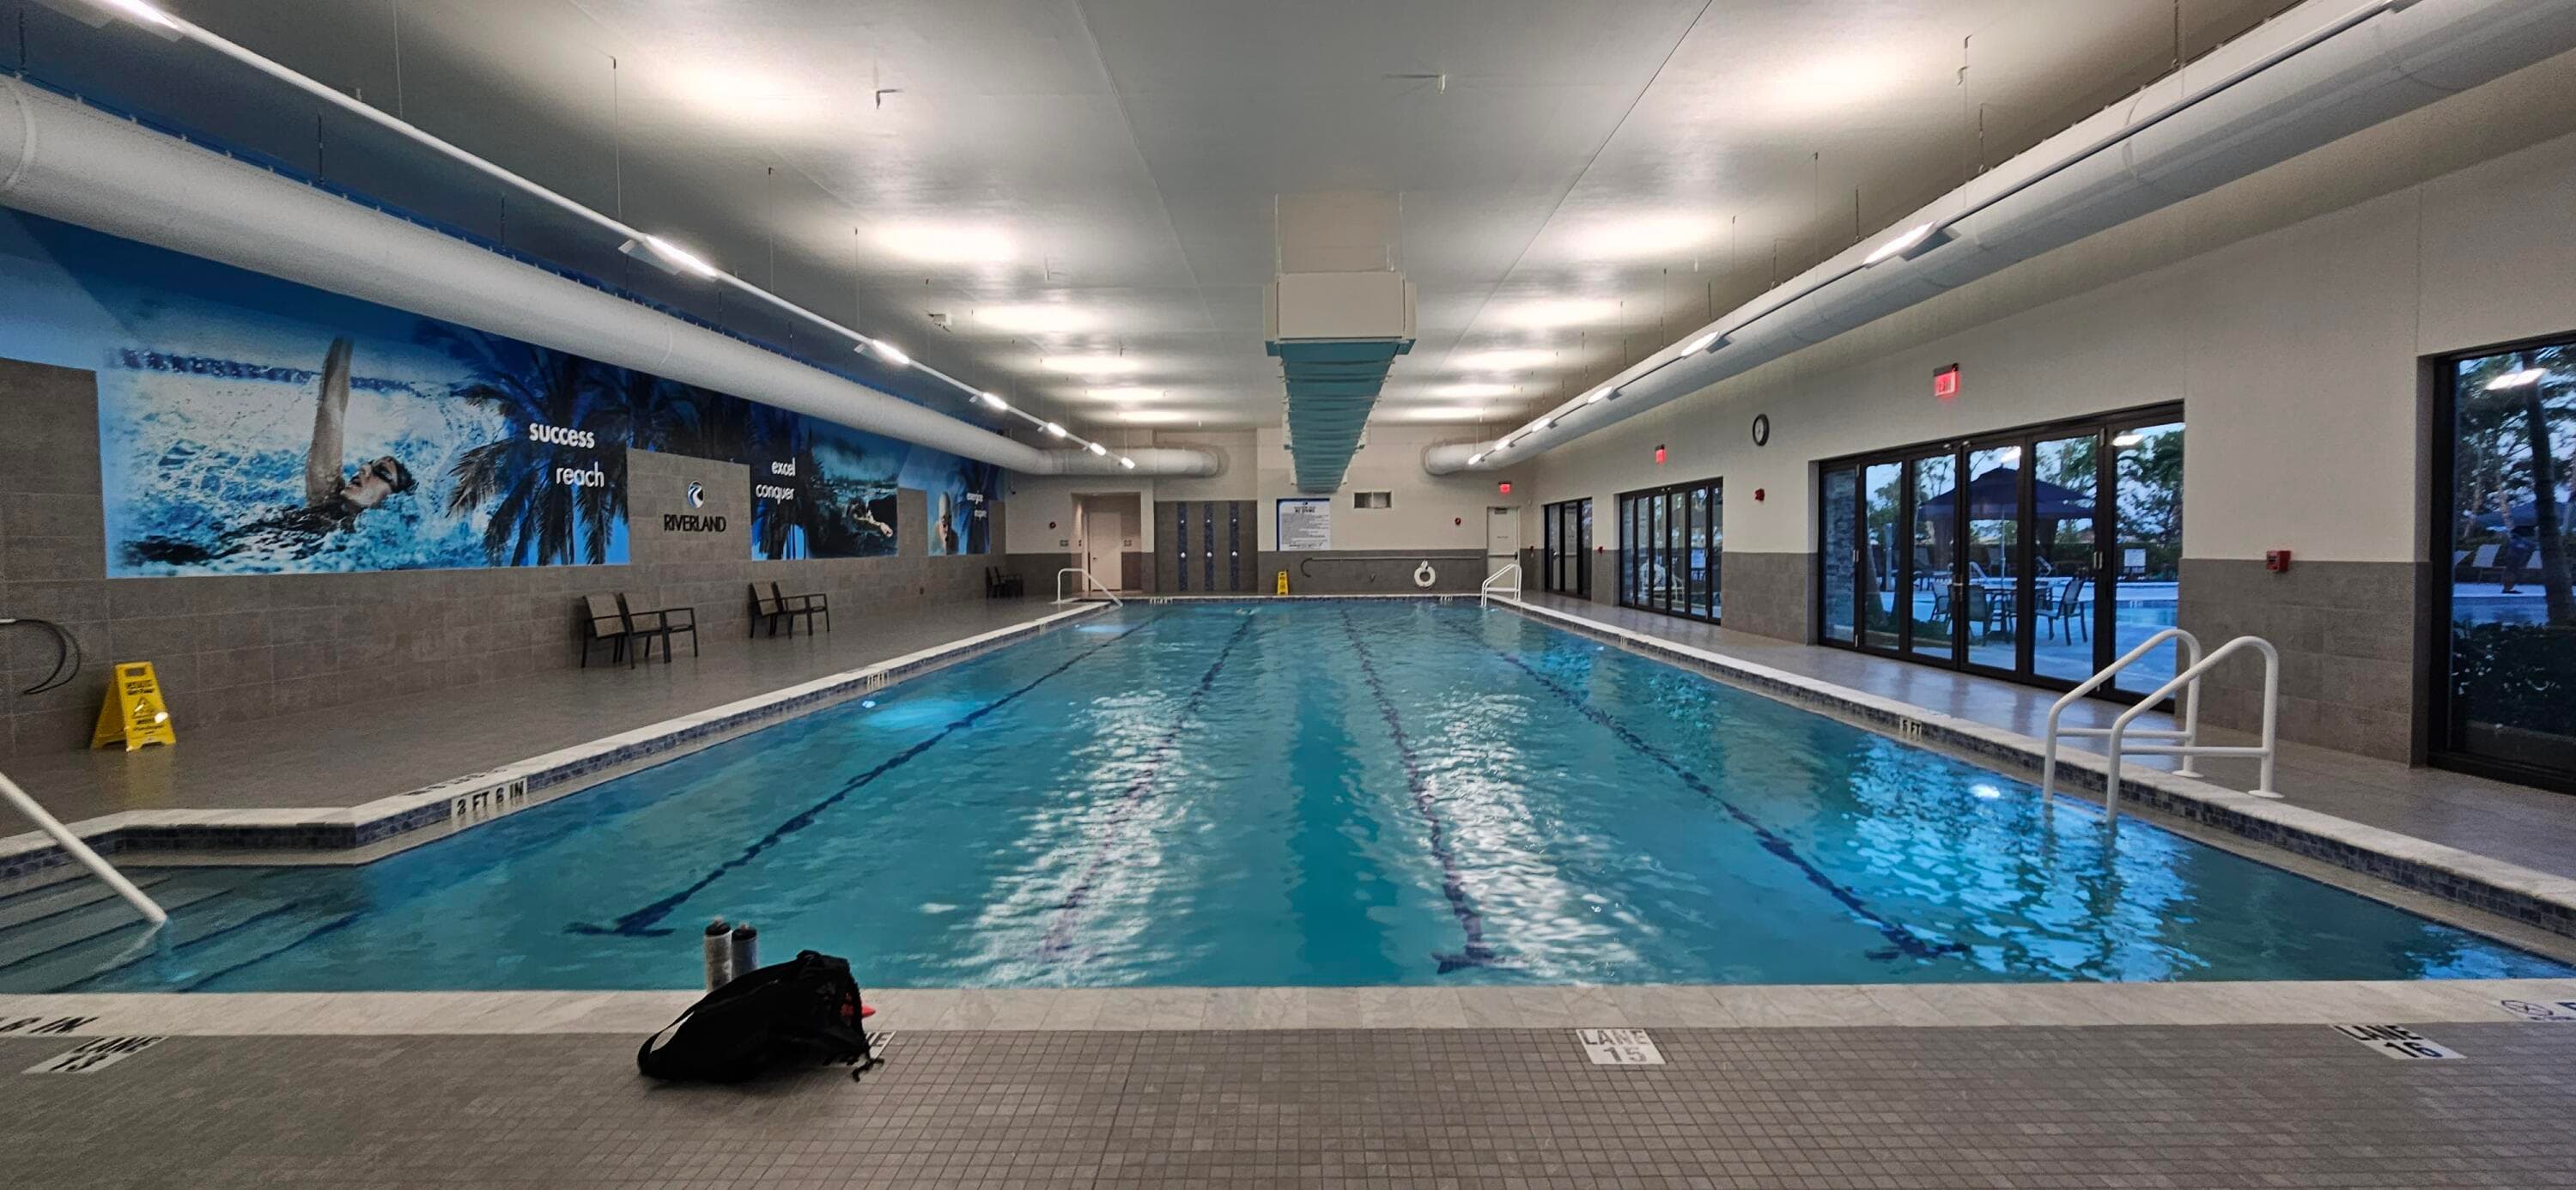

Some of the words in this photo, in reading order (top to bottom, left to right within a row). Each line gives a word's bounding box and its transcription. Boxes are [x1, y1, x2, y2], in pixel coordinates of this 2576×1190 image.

[529, 422, 595, 448] success
[556, 461, 605, 488] reach
[772, 457, 795, 477] excel
[756, 484, 795, 505] conquer
[664, 514, 726, 532] RIVERLAND
[472, 791, 489, 811] FT
[509, 780, 524, 799] IN
[1580, 1029, 1649, 1045] LANE
[2333, 1024, 2425, 1041] LANE
[72, 1036, 164, 1053] LANE
[2385, 1041, 2443, 1058] 16
[1603, 1047, 1647, 1062] 15
